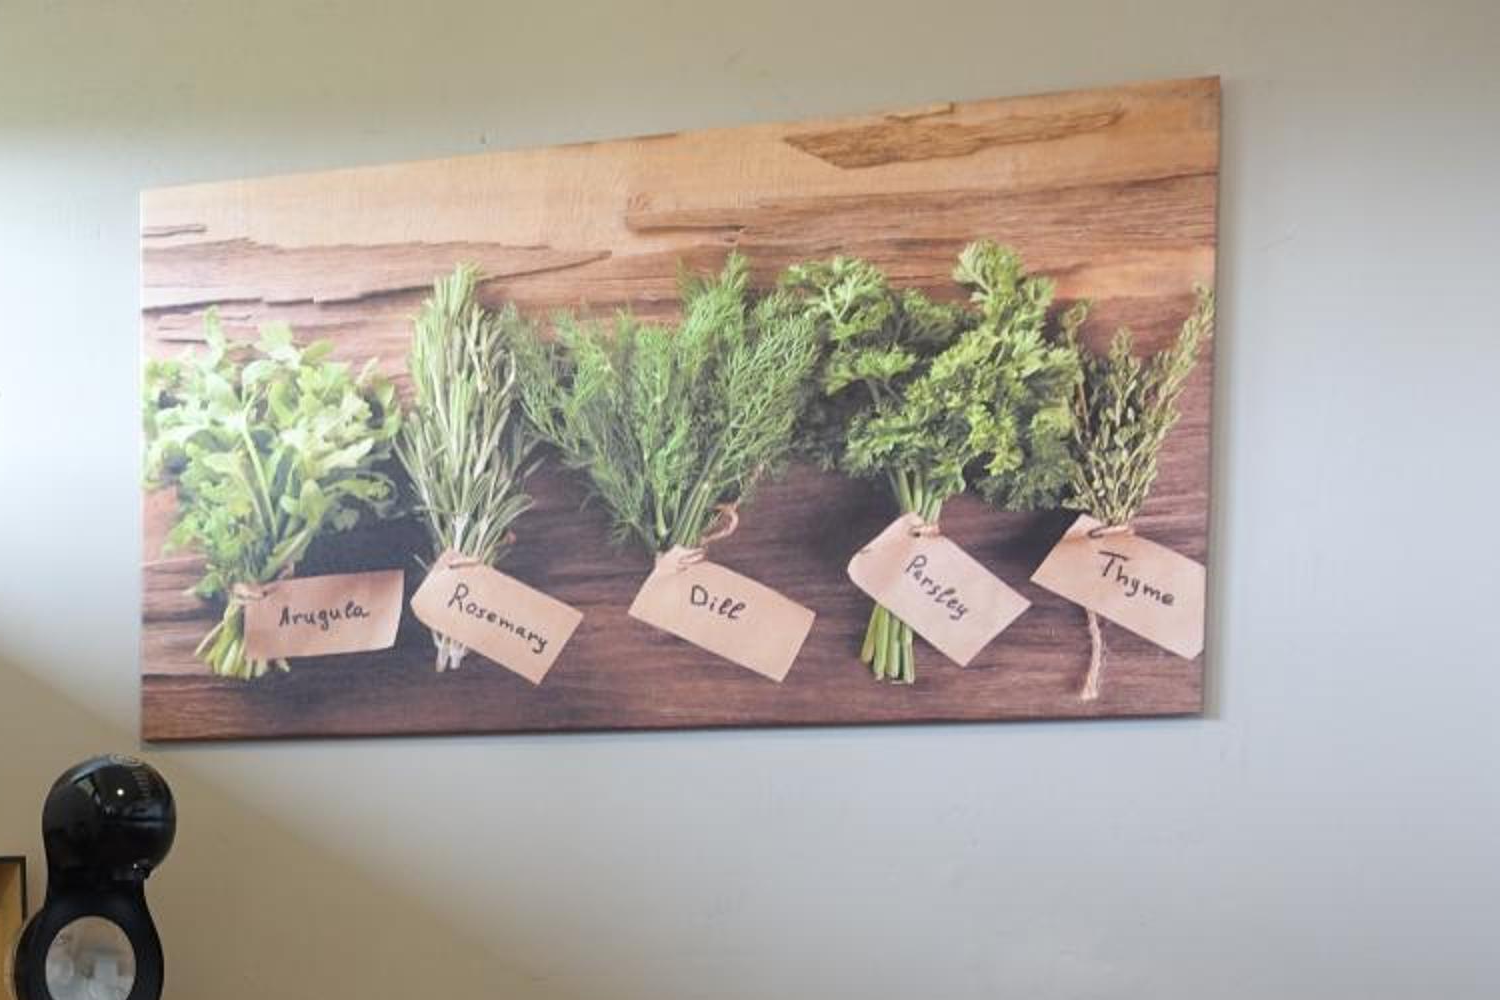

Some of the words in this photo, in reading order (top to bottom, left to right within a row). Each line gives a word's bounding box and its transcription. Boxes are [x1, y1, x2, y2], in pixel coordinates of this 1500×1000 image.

[688, 584, 746, 621] Dill
[903, 553, 969, 621] Parsley
[1097, 549, 1175, 607] Thyme
[278, 603, 371, 630] Arugula
[446, 582, 550, 655] Rosemary
